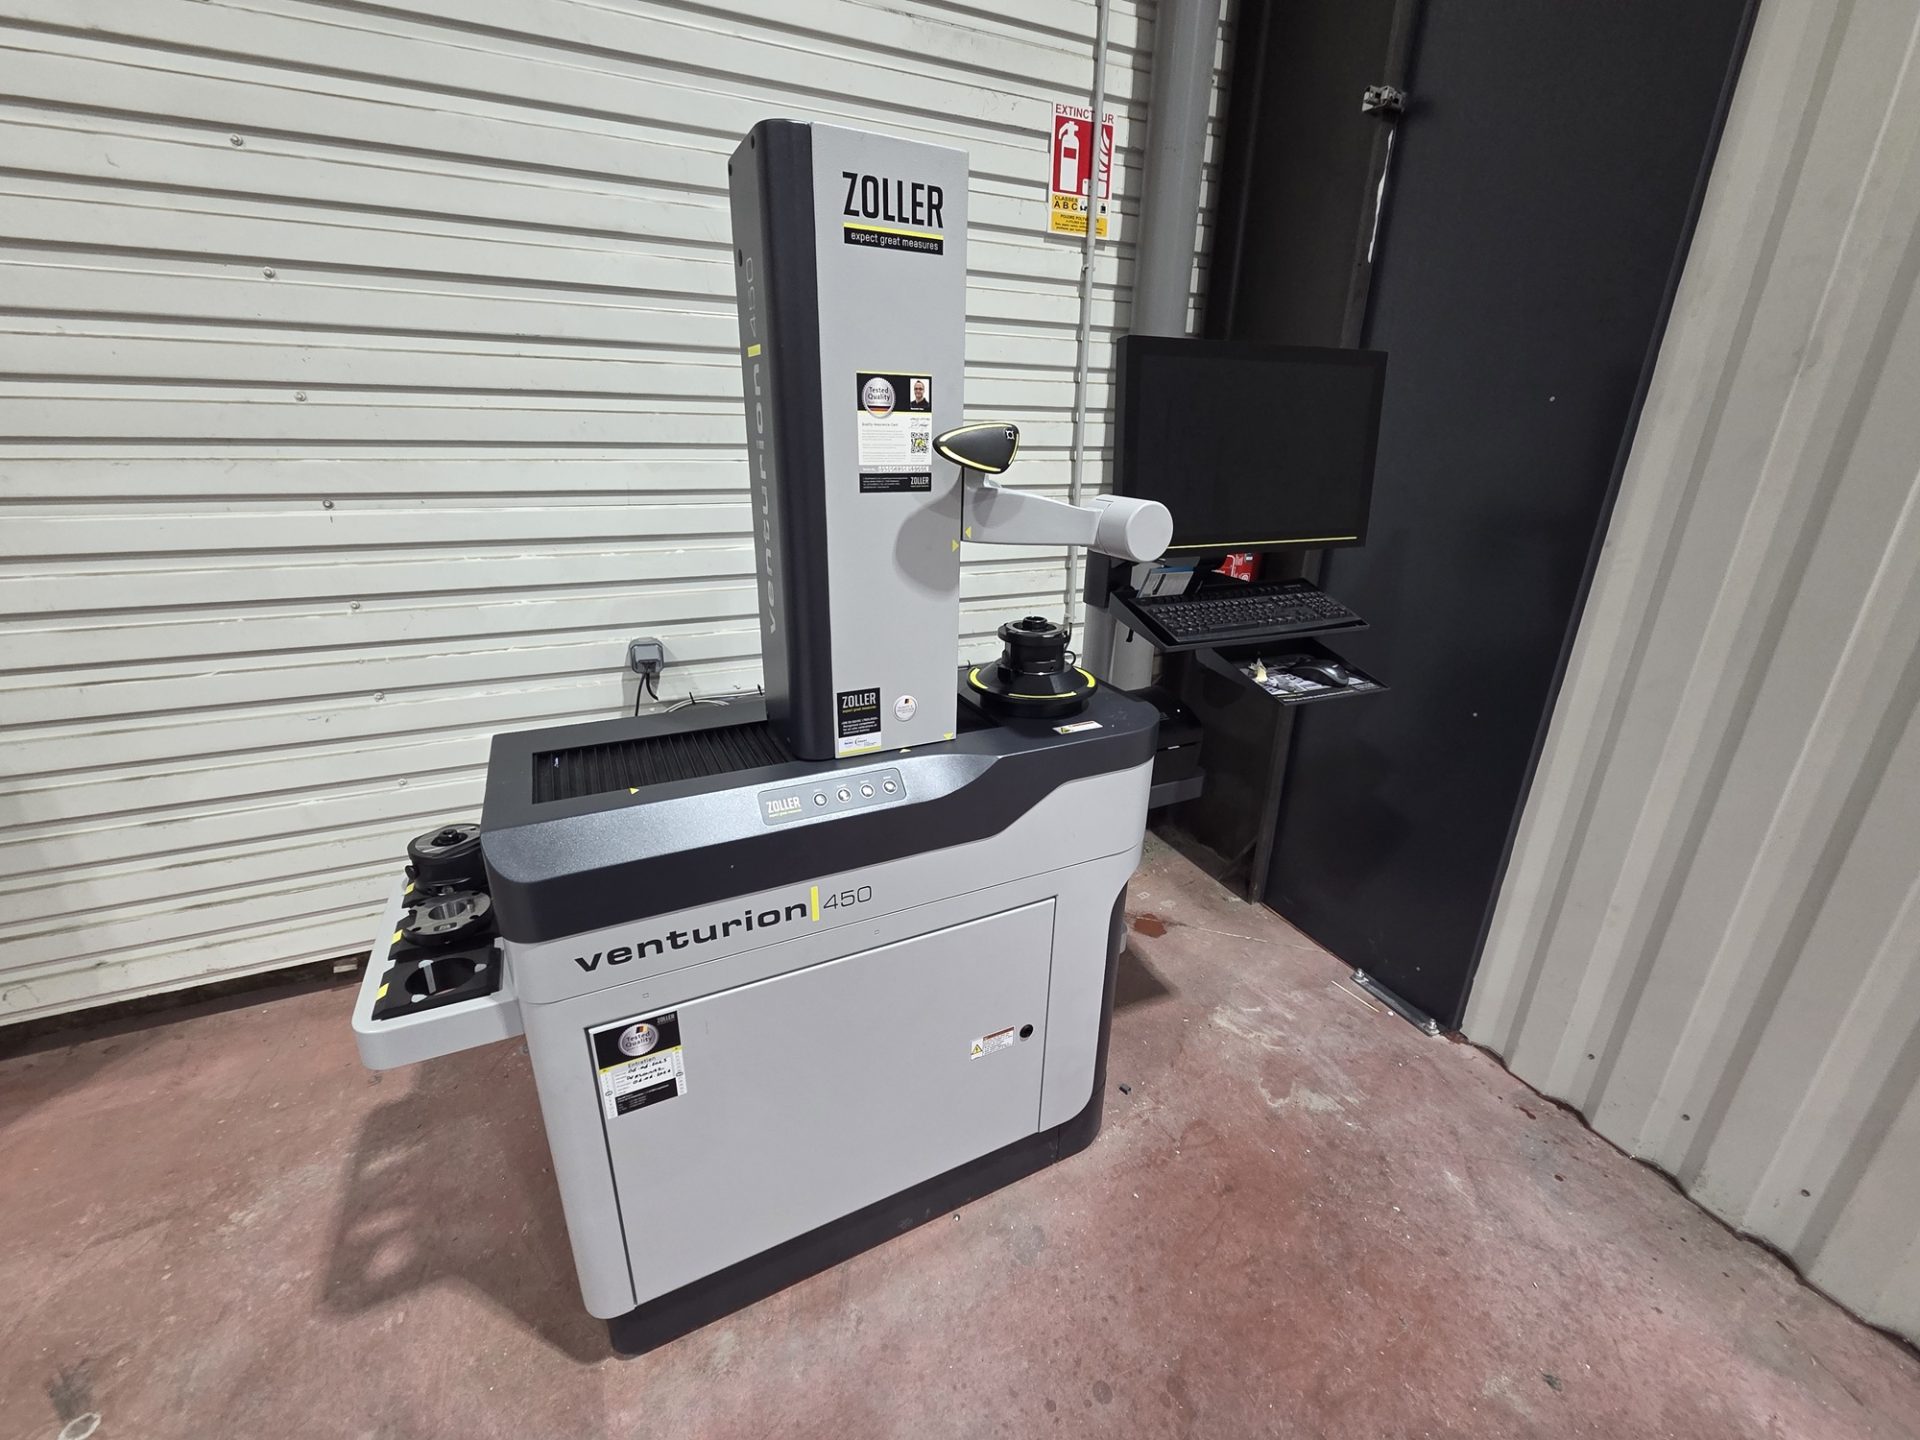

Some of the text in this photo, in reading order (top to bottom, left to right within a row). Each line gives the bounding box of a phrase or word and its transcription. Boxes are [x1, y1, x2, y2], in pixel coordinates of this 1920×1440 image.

[1055, 104, 1114, 124] EXTINCTUR
[842, 171, 944, 229] ZOLLER
[1071, 203, 1078, 211] C
[851, 231, 939, 251] expect great measures
[867, 393, 890, 401] Quality
[911, 476, 929, 485] ZOLLER
[754, 364, 776, 634] venturion
[841, 692, 877, 709] ZOLLER
[766, 796, 801, 814] ZOLLER
[574, 885, 872, 973] venturion 450
[625, 1037, 652, 1048] Quality
[627, 1031, 651, 1042] Tested
